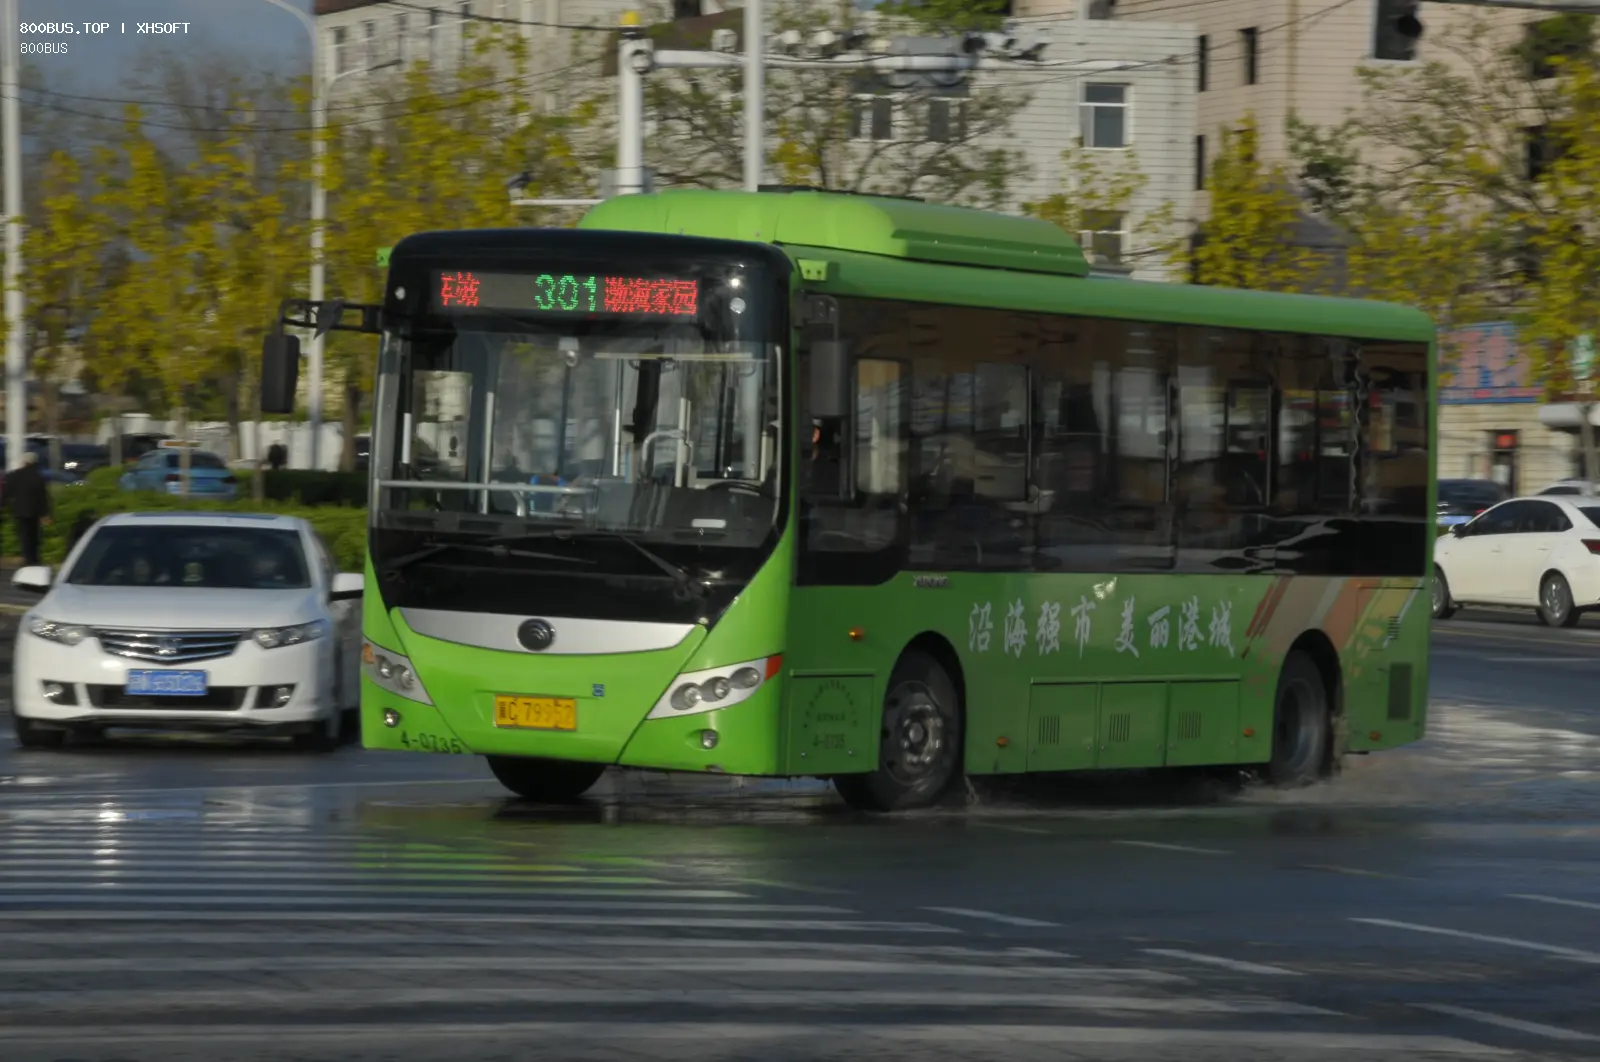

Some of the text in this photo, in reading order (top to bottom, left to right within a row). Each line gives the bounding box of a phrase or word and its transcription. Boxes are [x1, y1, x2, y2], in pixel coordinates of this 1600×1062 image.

[534, 274, 597, 311] 301
[603, 276, 698, 315] 渤海家园
[968, 595, 1235, 659] 沿海强市 美丽港城
